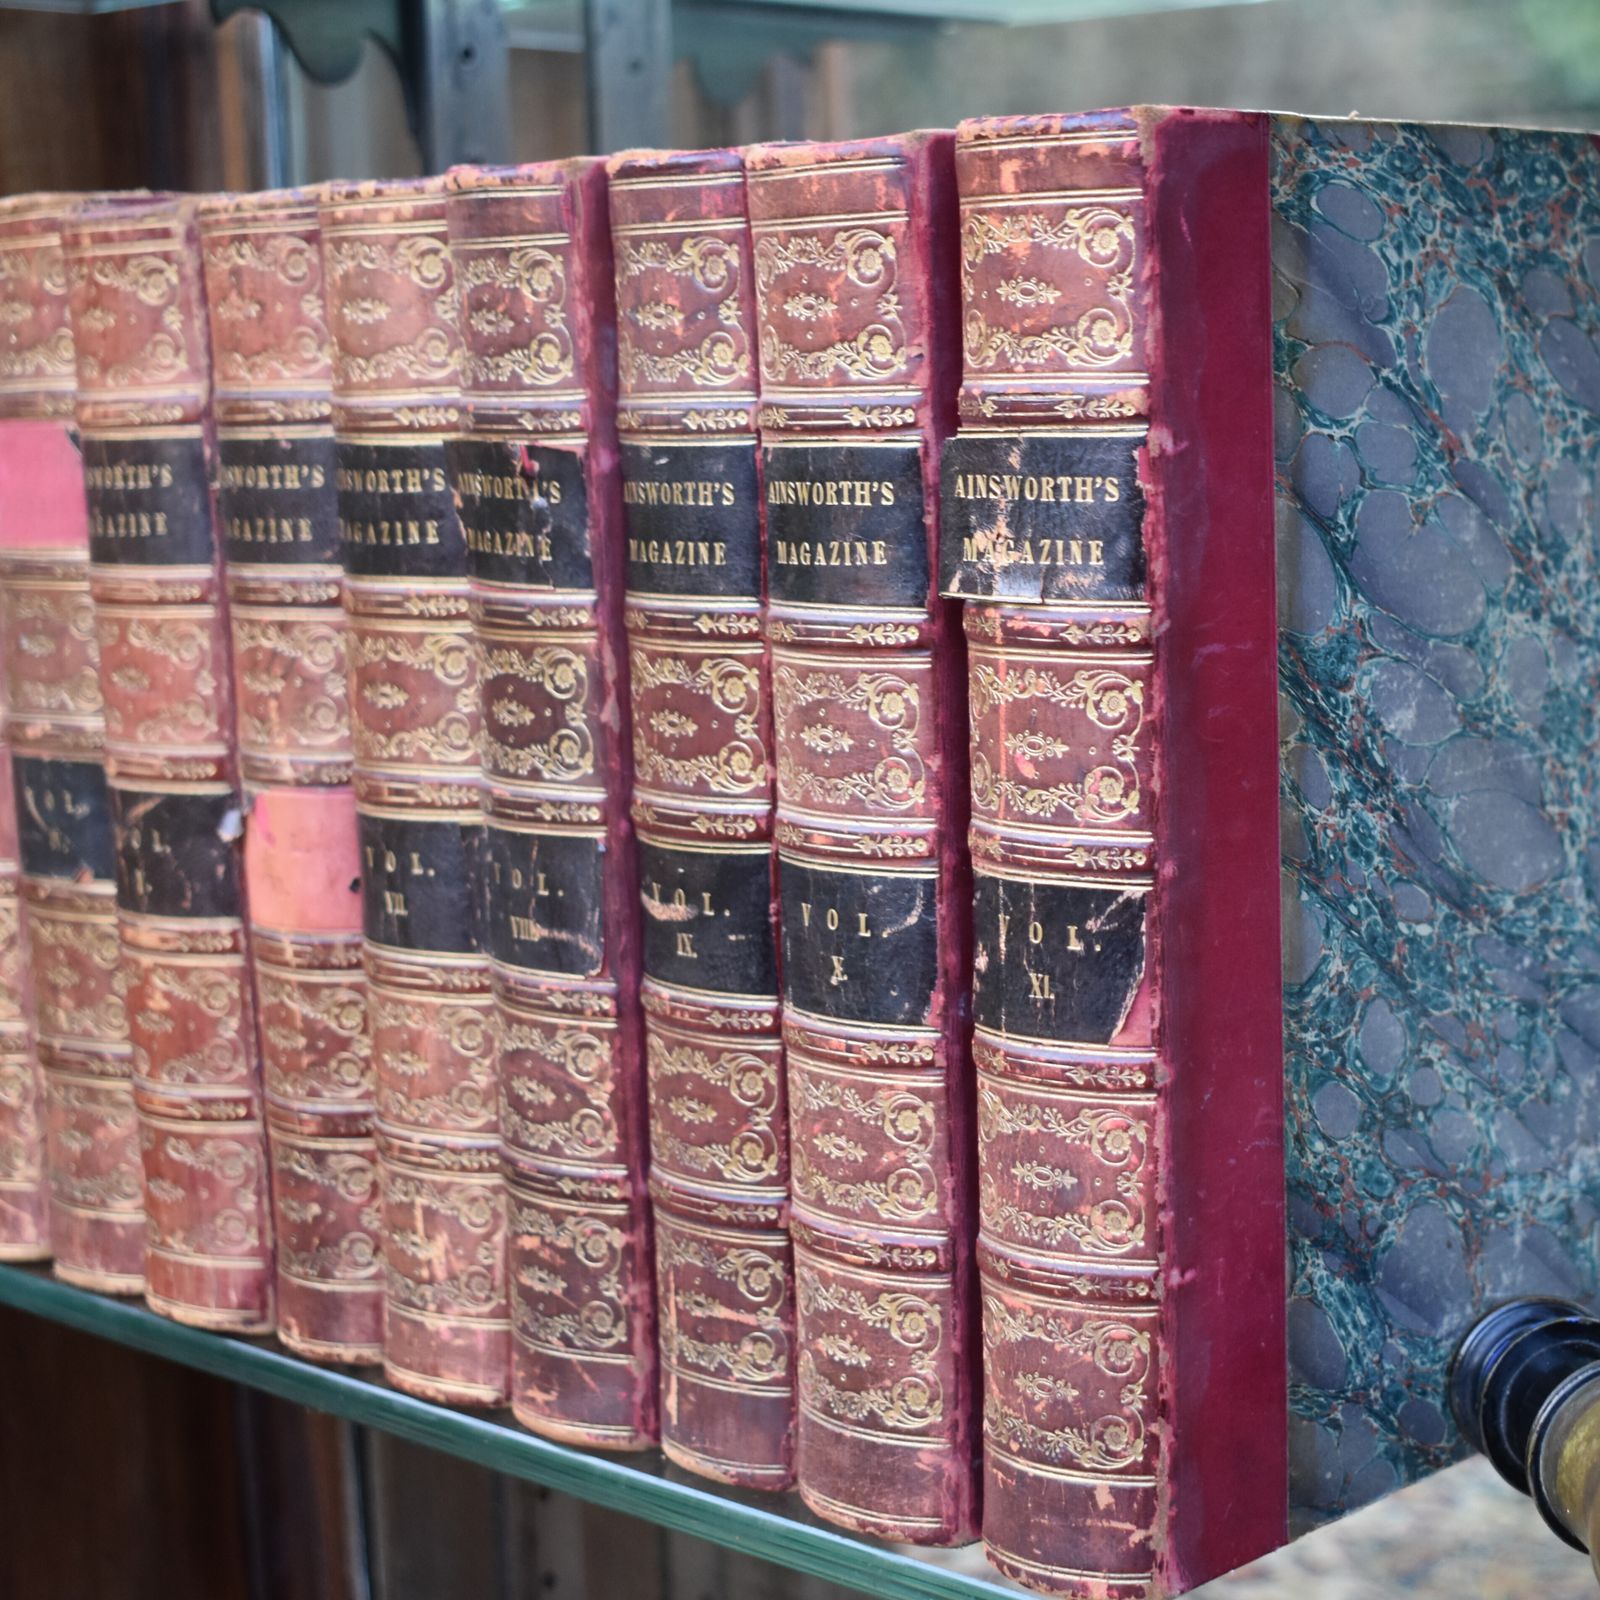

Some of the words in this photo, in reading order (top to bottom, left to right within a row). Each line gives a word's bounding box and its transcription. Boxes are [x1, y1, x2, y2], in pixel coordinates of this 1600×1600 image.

[768, 480, 895, 507] AINSWORTH'S
[954, 474, 1120, 503] AINSWORTH'S
[628, 537, 727, 566] MAGAZINE
[777, 540, 888, 567] MAGAZINE
[963, 536, 1105, 566] MAGAZINE
[998, 914, 1102, 952] VOL.
